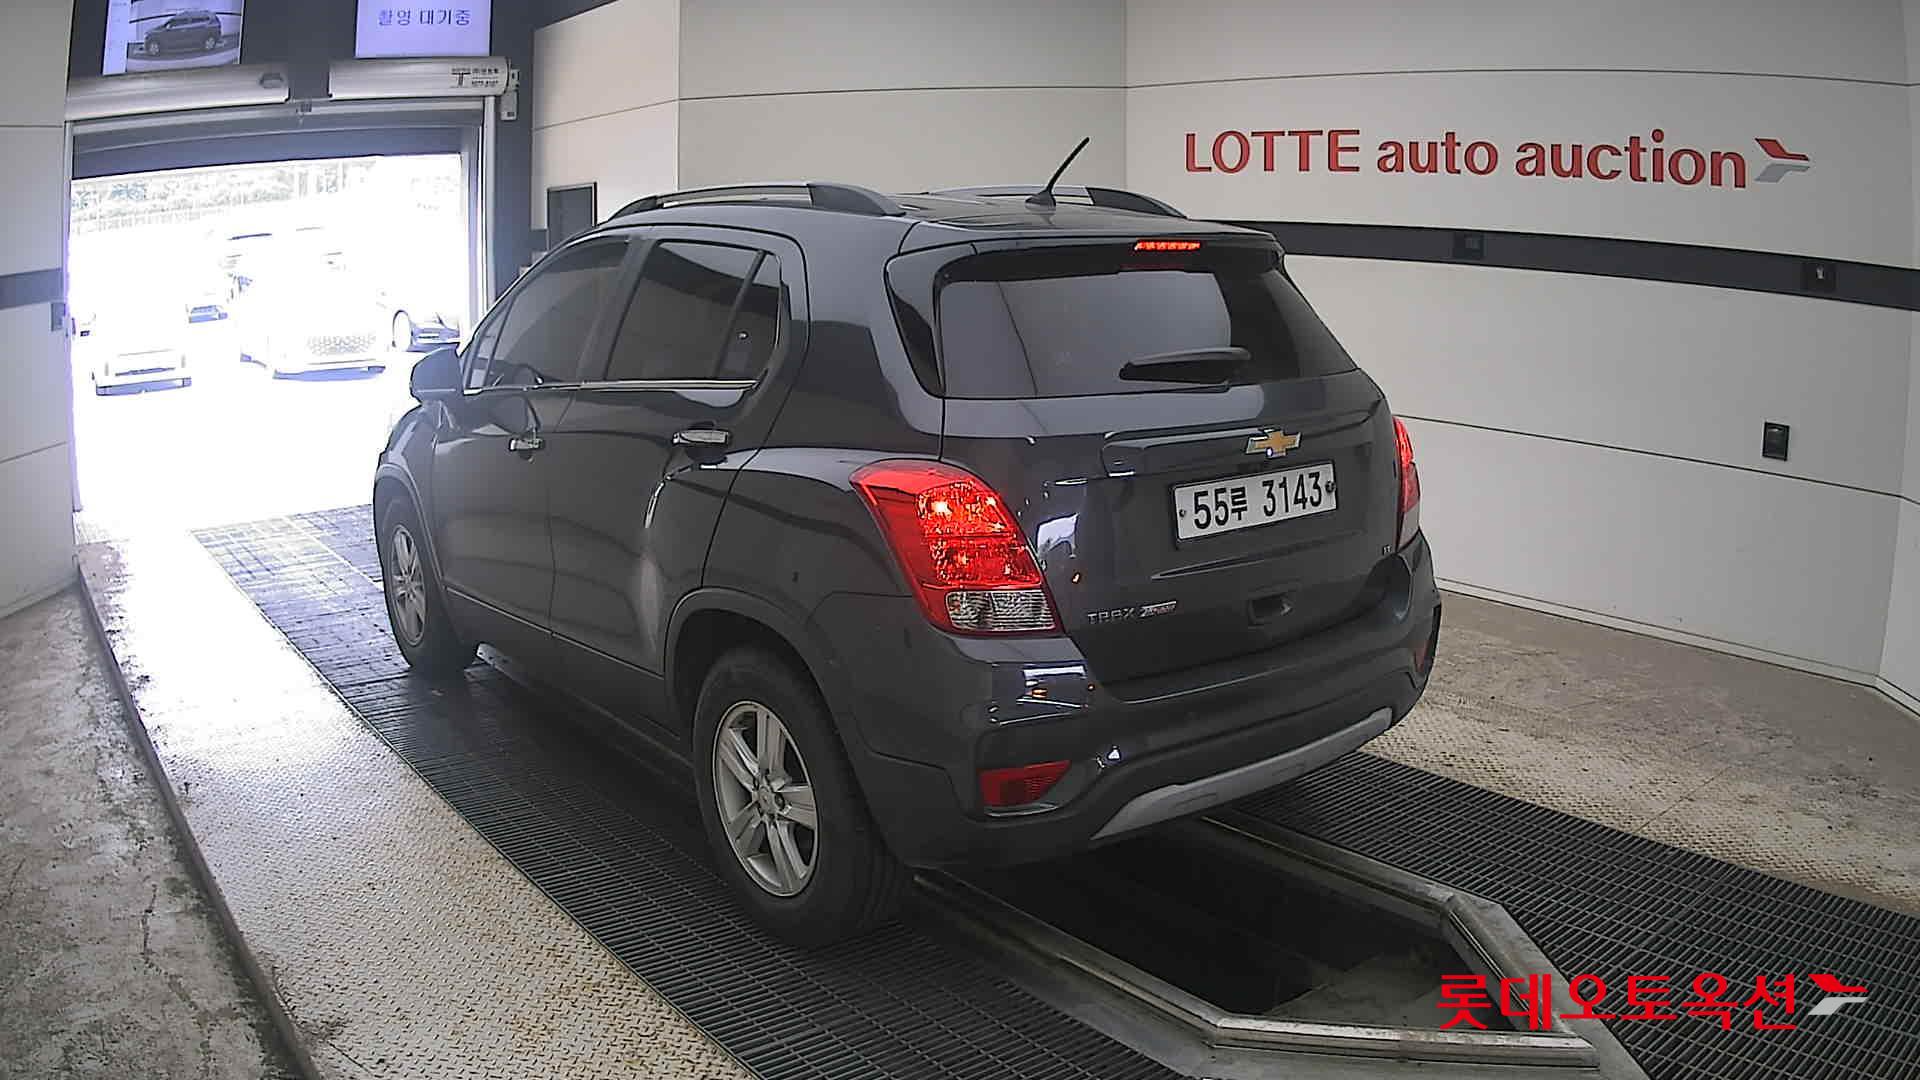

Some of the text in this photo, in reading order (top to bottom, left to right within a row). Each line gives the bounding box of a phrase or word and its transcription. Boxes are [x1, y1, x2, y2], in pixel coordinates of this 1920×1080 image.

[420, 9, 471, 26] 대기중
[1185, 129, 1747, 188] LOTTE auto auction
[1194, 471, 1323, 530] 55루 3143
